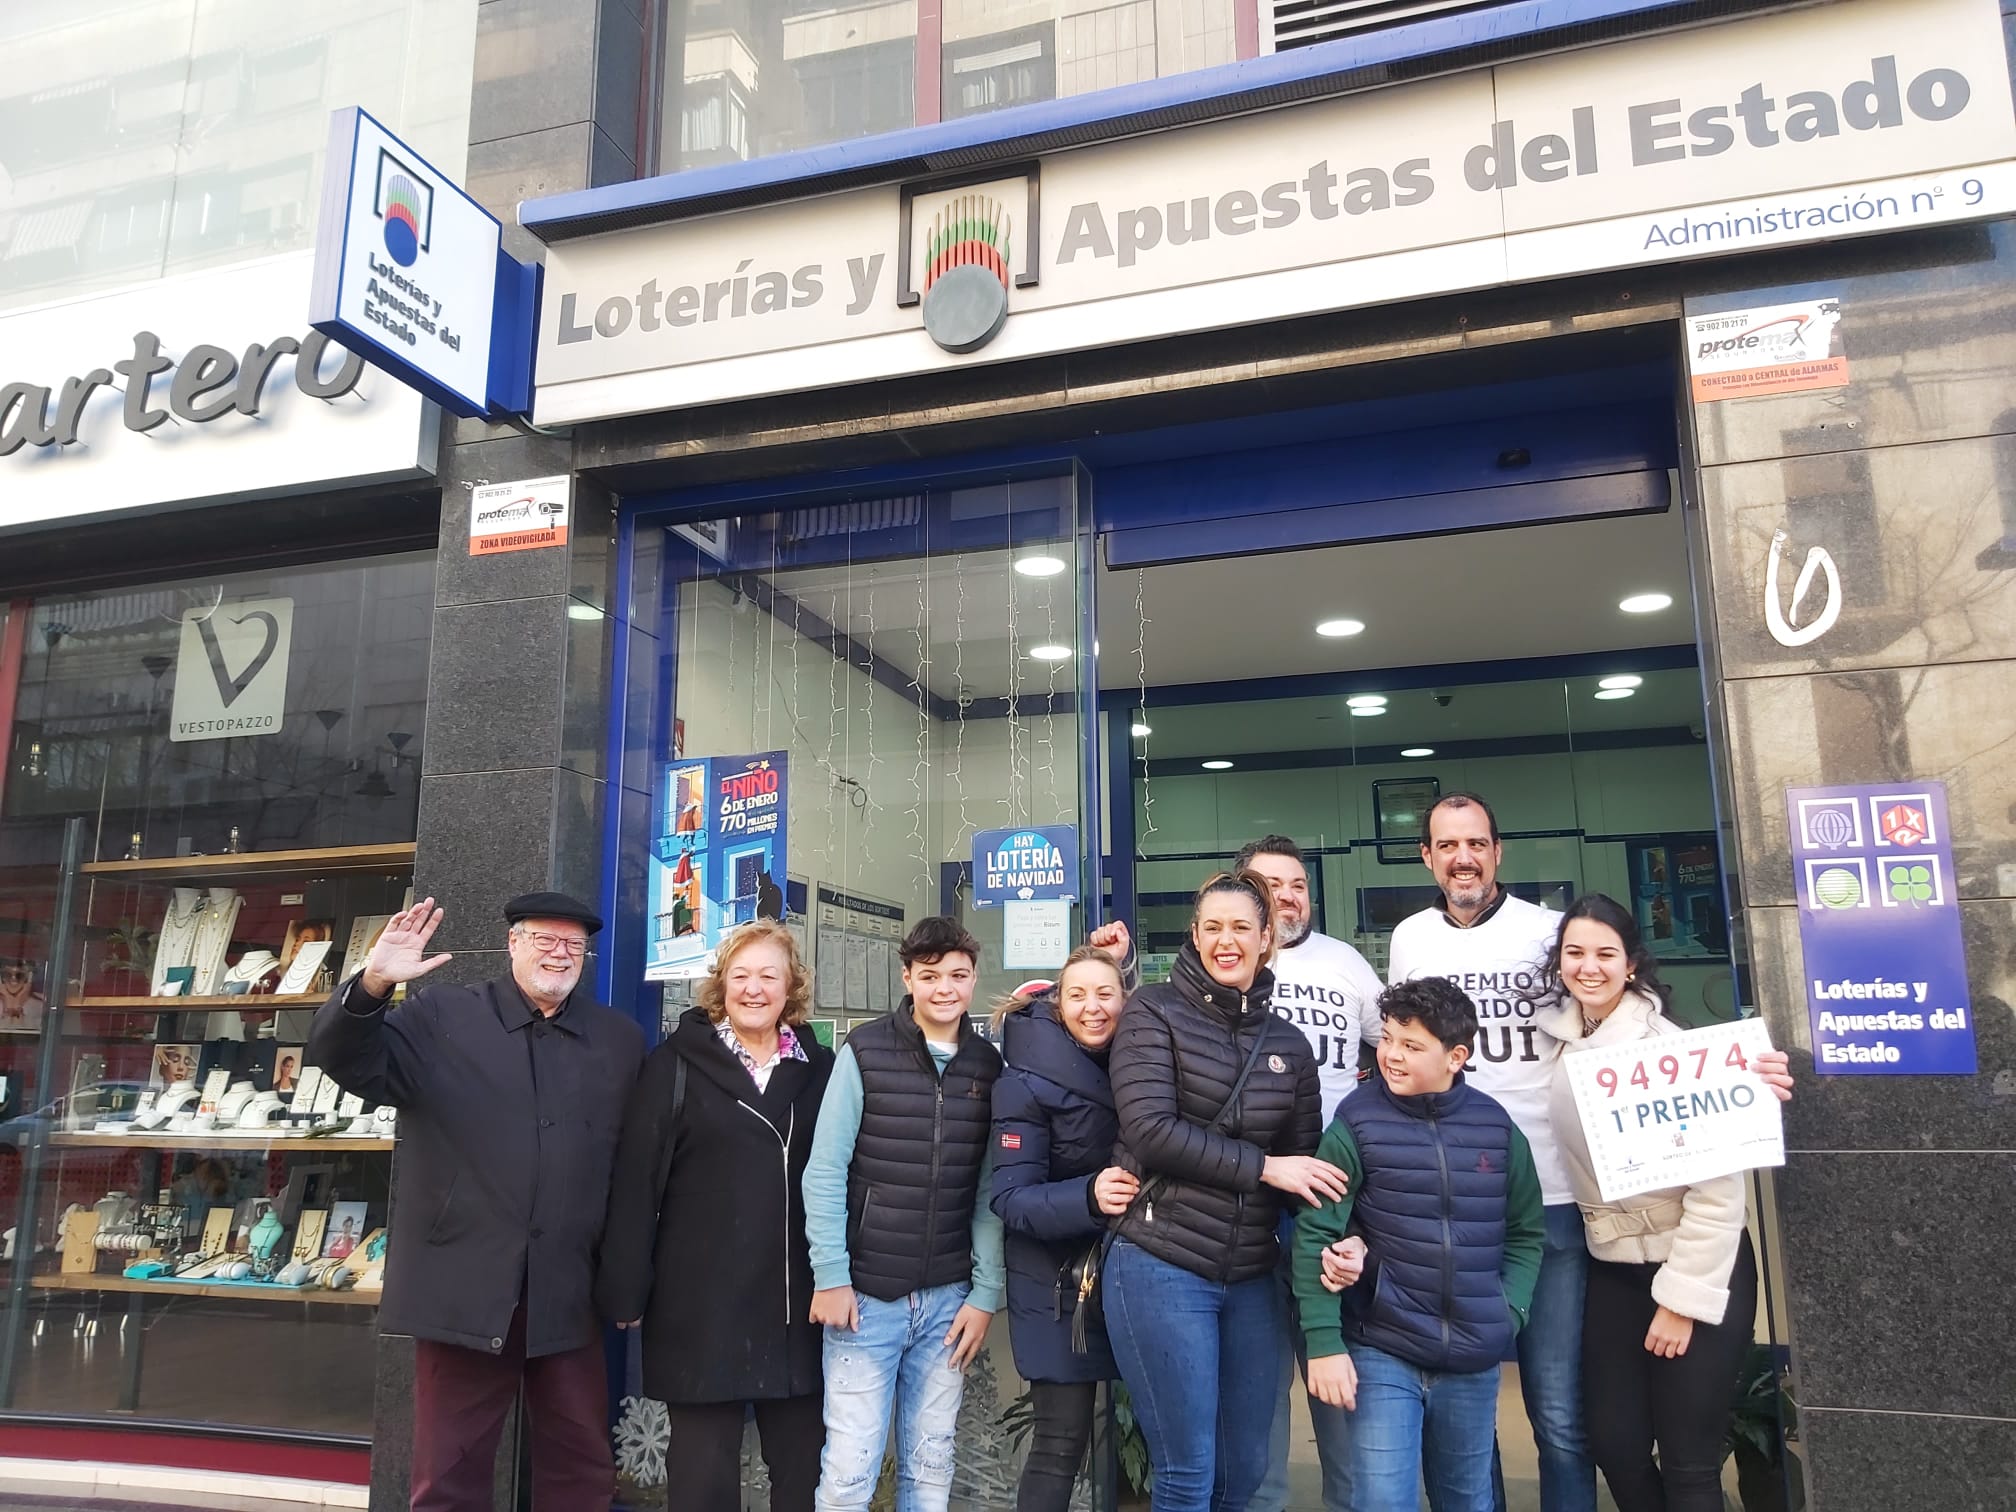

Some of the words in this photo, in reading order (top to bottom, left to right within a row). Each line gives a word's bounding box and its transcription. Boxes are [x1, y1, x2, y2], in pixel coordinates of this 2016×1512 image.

[557, 258, 824, 346] Loterías
[845, 253, 886, 316] y
[1056, 157, 1435, 268] Apuestas
[1462, 105, 1599, 192] del
[1627, 54, 1971, 167] Estado
[1643, 193, 1899, 250] Administración
[1961, 178, 1984, 206] 9
[368, 251, 430, 307] Loterías
[431, 300, 442, 318] y
[363, 299, 417, 346] Estado
[366, 277, 436, 335] Apuestas
[439, 326, 461, 352] del
[1705, 323, 1719, 331] 902
[1721, 320, 1729, 329] 70
[1730, 319, 1738, 328] 21
[1740, 318, 1748, 327] 21
[1701, 374, 1747, 387] CONECTADO
[1755, 369, 1789, 381] CENTRAL
[1801, 363, 1839, 375] ALARMAS
[0, 330, 366, 456] artero
[480, 538, 499, 549] ZONA
[500, 531, 556, 547] VIDEOVIGILADA
[179, 715, 273, 734] VESTOPAZZO
[732, 768, 778, 800] NIÑO
[720, 795, 732, 815] 6
[732, 799, 746, 813] DE
[746, 792, 778, 810] ENERO
[720, 812, 746, 833] 770
[1014, 835, 1035, 848] HAY
[987, 843, 1064, 872] LOTERÍA
[987, 873, 1004, 889] DE
[1007, 869, 1064, 888] NAVIDAD
[1447, 972, 1533, 990] REMIO
[1814, 978, 1909, 1000] Loterías
[1912, 981, 1928, 1003] y
[1276, 983, 1345, 1007] EMIO
[1273, 1005, 1348, 1031] DIDO
[1478, 998, 1535, 1018] IDO
[1818, 1010, 1924, 1035] Apuestas
[1929, 1007, 1966, 1029] del
[1463, 1020, 1540, 1072] UÍ
[1821, 1042, 1900, 1063] Estado
[1596, 1042, 1748, 1098] 94974
[1635, 1084, 1755, 1128] PREMIO
